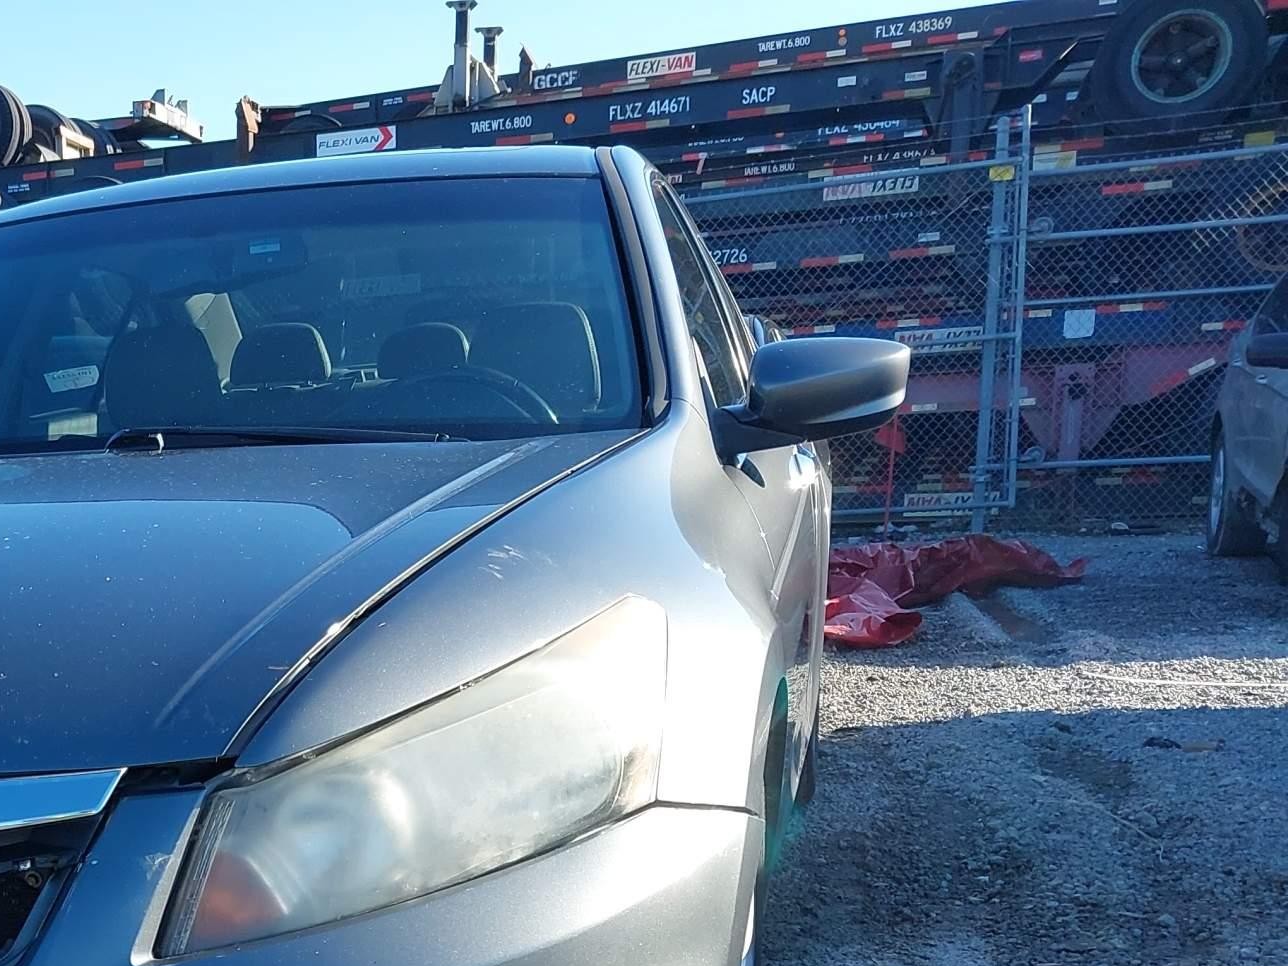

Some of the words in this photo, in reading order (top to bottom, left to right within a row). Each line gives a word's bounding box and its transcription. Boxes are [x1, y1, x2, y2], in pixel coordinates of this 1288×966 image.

[875, 23, 904, 39] FLXZ
[908, 16, 952, 34] 438369
[629, 54, 694, 77] FLEXI-VAN
[742, 87, 776, 104] SACP
[609, 102, 643, 121] FLXZ
[646, 95, 690, 115] 414671
[355, 134, 381, 145] VAN
